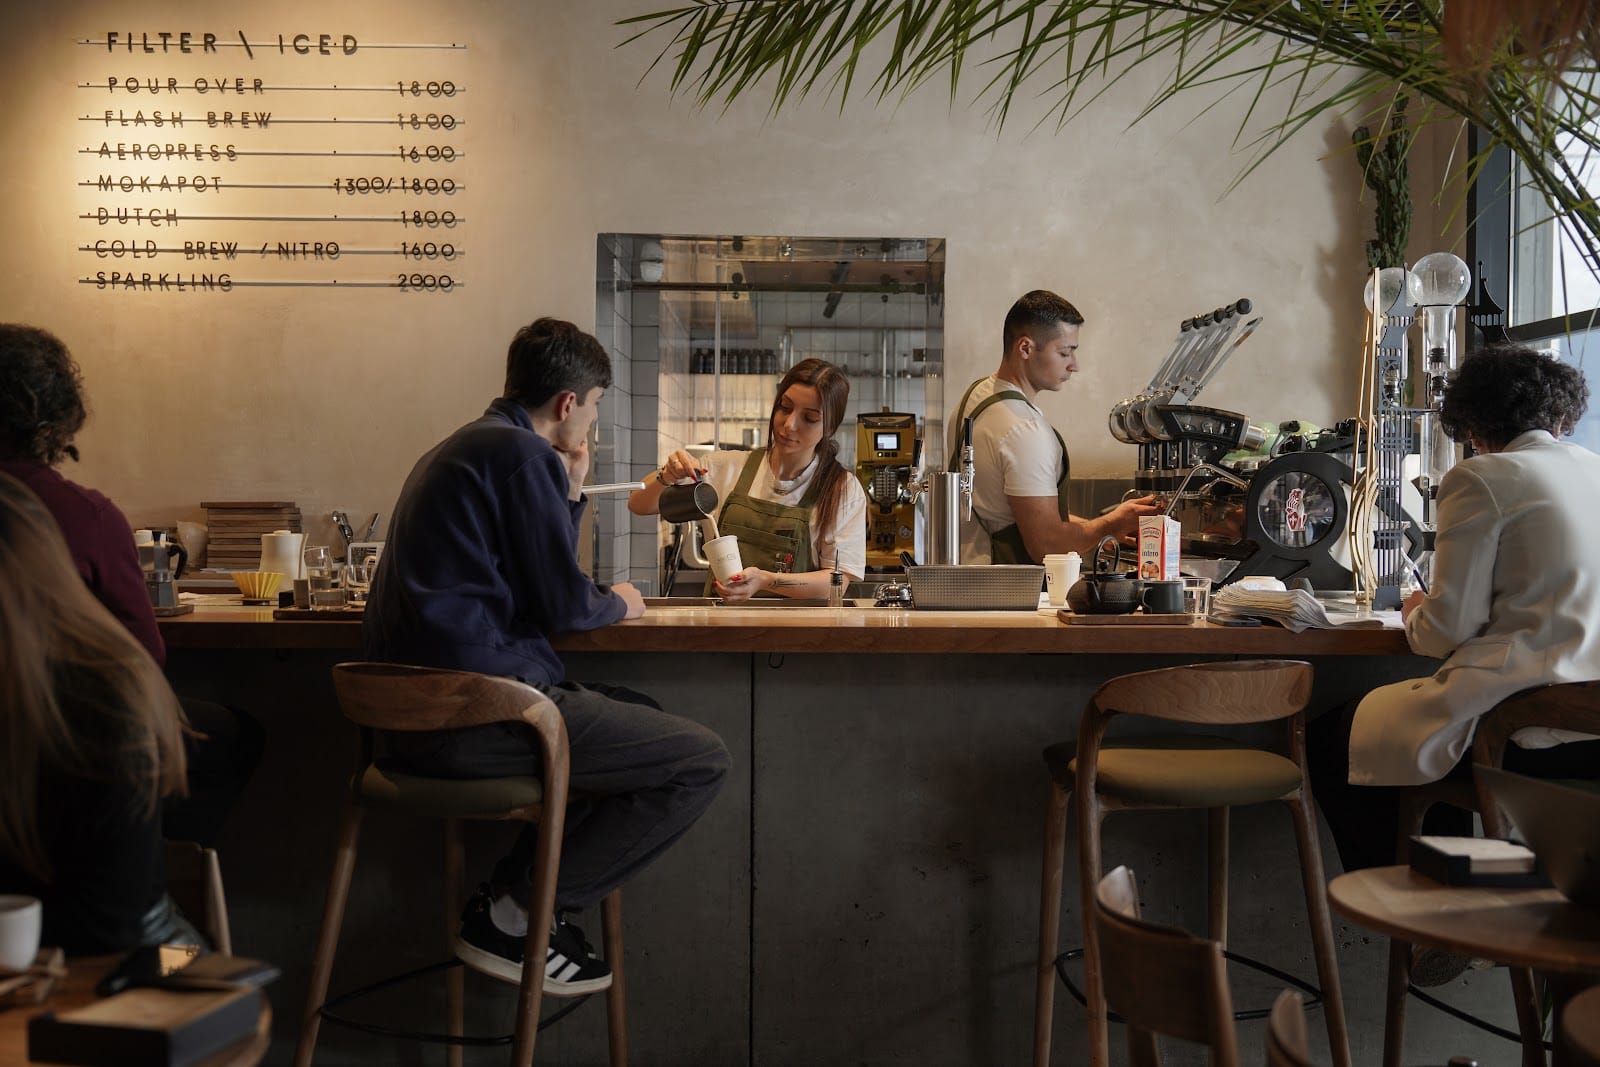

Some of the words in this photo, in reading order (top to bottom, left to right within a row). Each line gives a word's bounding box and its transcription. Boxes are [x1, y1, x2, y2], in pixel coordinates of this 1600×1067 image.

[107, 31, 217, 53] FILTER
[278, 33, 358, 55] ICED
[108, 76, 178, 93] POUR
[194, 77, 264, 94] OVER
[397, 80, 456, 97] 1800
[104, 109, 184, 127] FLASH
[207, 111, 272, 128] BREW
[397, 112, 456, 130] 1800
[99, 141, 238, 161] AEROPRESS
[398, 145, 456, 162] 1600
[97, 207, 179, 226] DUTCH
[400, 210, 456, 228] 1800
[95, 239, 158, 258] COLD
[184, 241, 239, 260] BREW
[401, 241, 456, 260] 1600
[96, 271, 233, 292] SPARKLING
[397, 273, 454, 292] 2000
